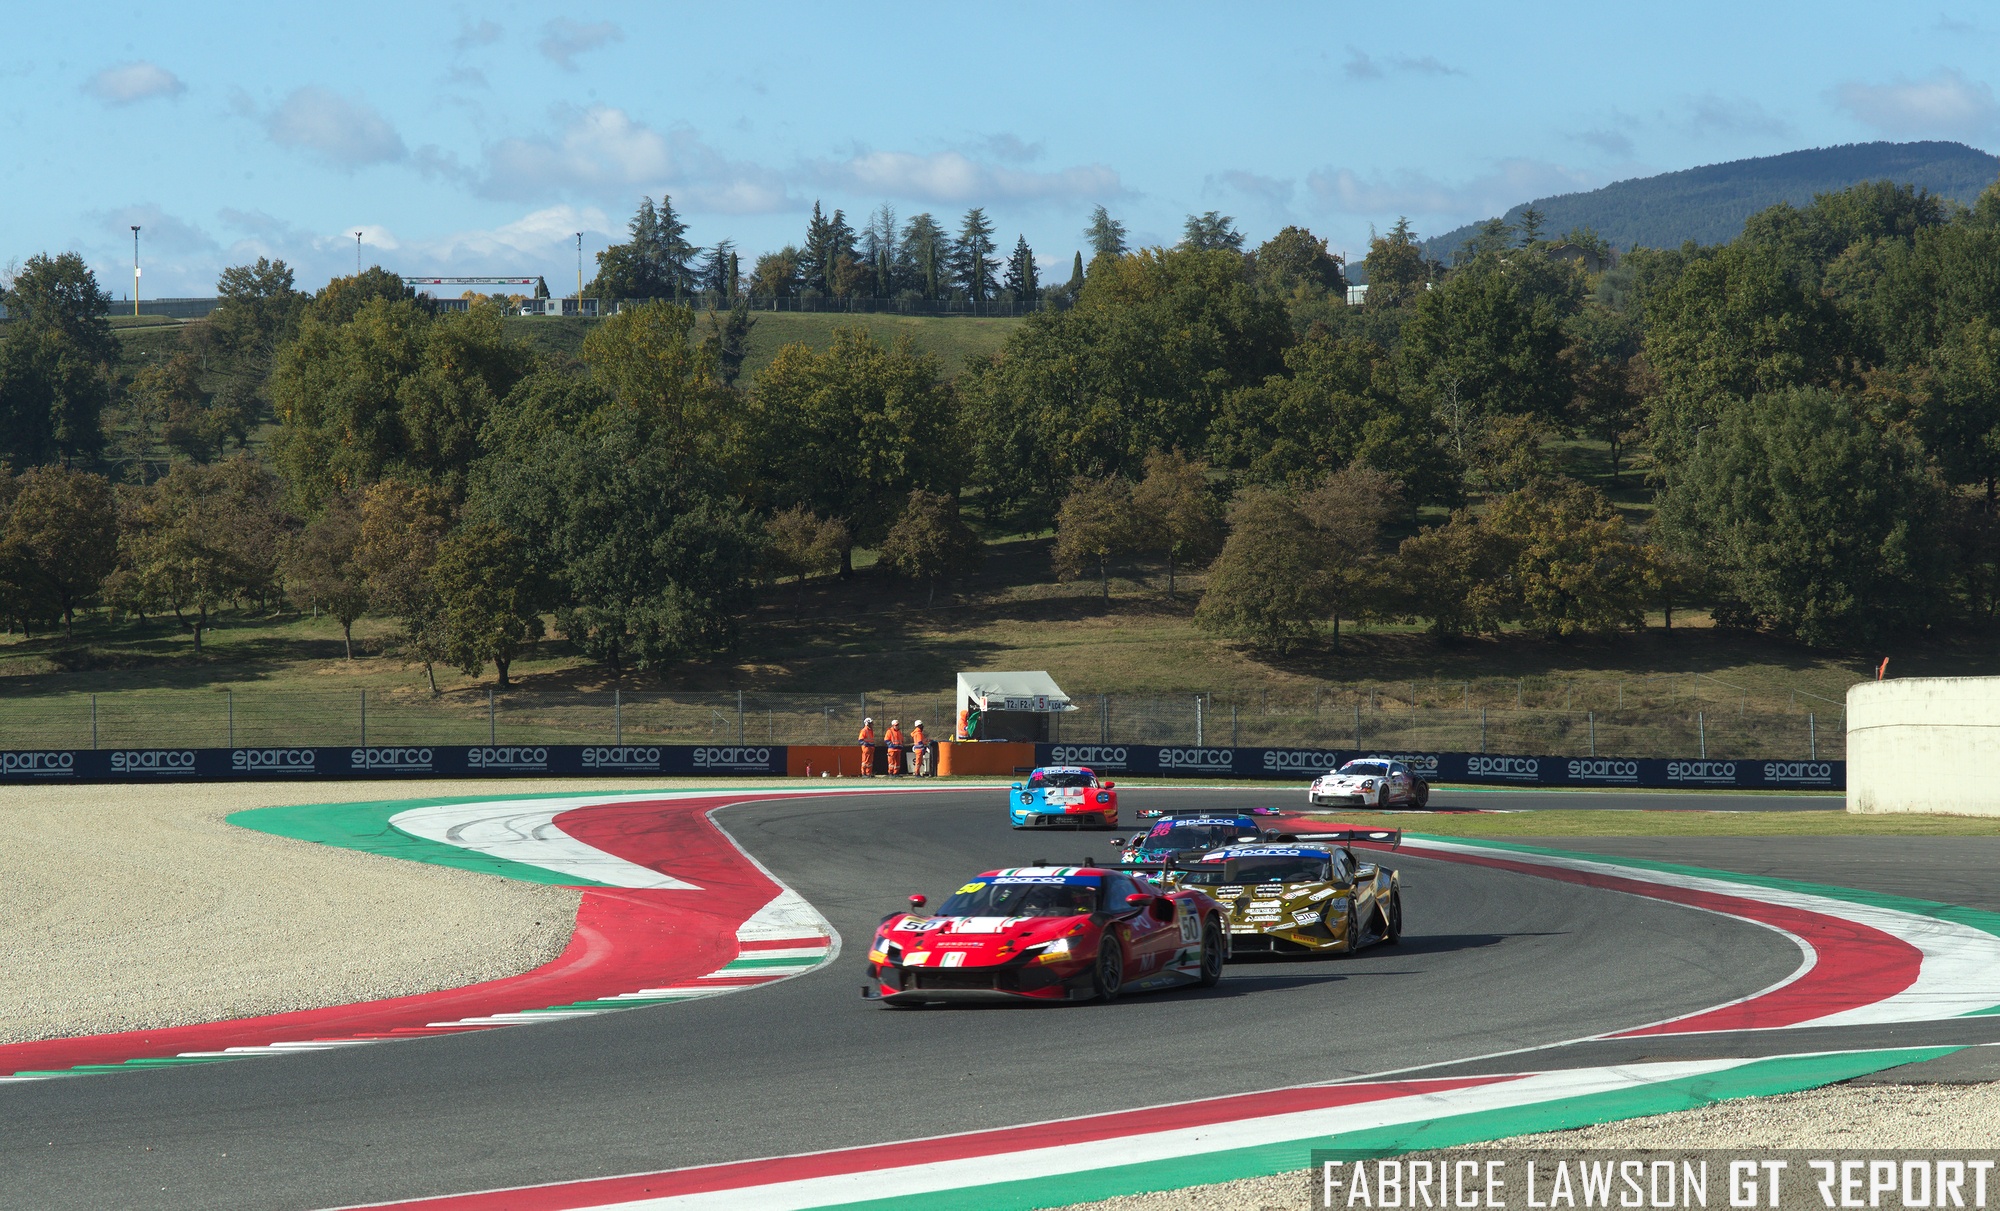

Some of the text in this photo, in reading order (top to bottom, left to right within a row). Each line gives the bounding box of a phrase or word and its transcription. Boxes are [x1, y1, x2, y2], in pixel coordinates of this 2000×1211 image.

[1039, 698, 1044, 709] 5
[110, 751, 195, 773] sparco
[232, 750, 315, 771] sparco
[351, 748, 433, 769] sparco
[467, 748, 547, 768] sparco
[581, 747, 660, 768] sparco
[693, 748, 770, 768] sparco
[1051, 746, 1127, 767] sparco
[1158, 748, 1233, 768] sparco
[1263, 750, 1336, 771] sparco
[1467, 757, 1538, 776] sparco
[1568, 760, 1638, 780] sparco
[1667, 762, 1735, 781] sparco
[1764, 763, 1831, 782] sparco
[1175, 819, 1235, 827] sparco
[1227, 848, 1301, 857] sparco
[903, 921, 937, 930] 50
[1182, 915, 1199, 940] 50
